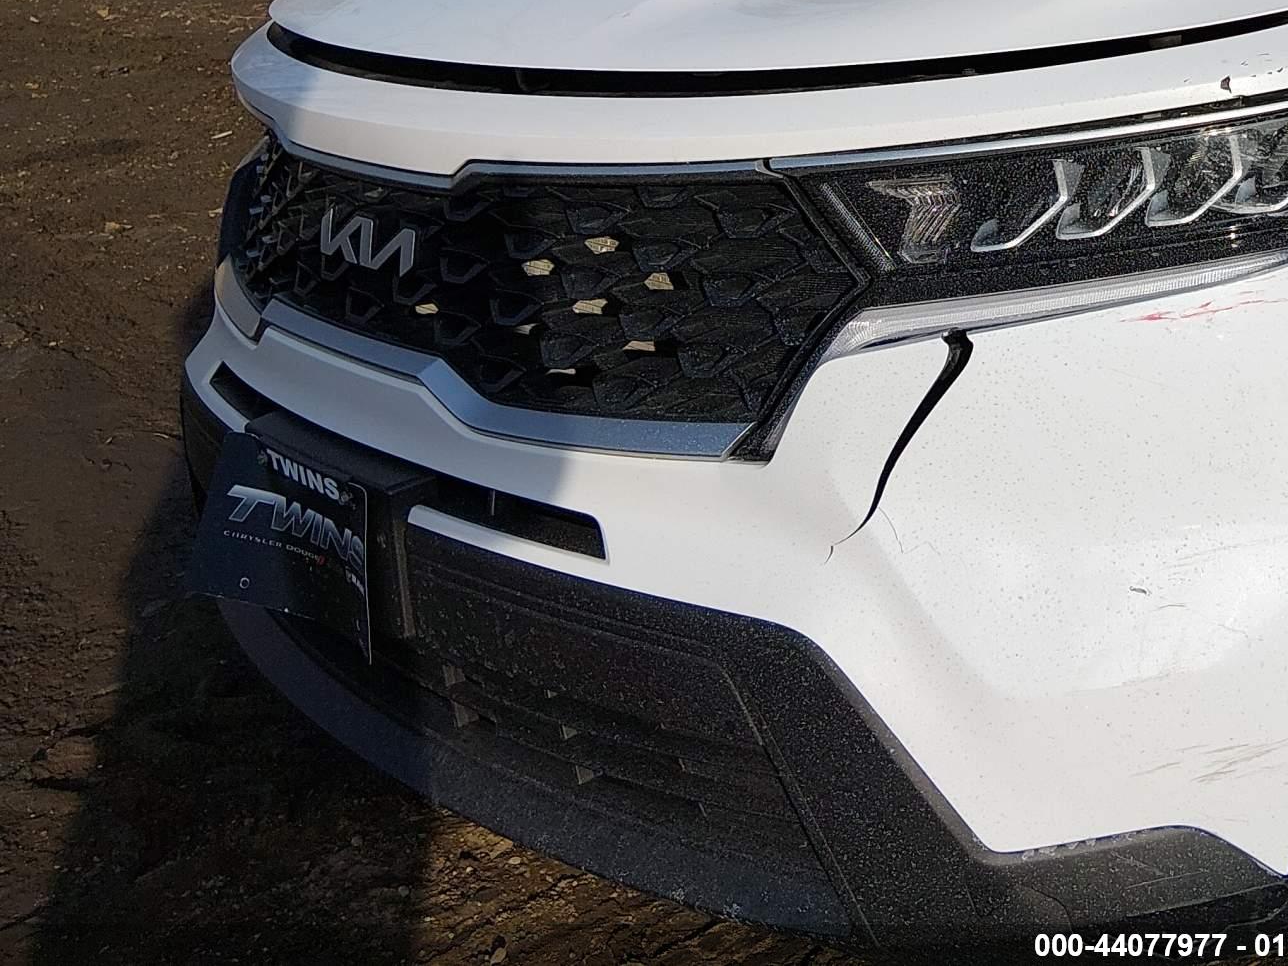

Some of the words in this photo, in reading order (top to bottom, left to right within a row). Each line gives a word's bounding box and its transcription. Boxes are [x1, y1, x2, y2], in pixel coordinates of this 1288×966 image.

[266, 448, 340, 502] TWINS
[223, 529, 283, 550] CHRYSLER
[226, 485, 366, 570] TWINS
